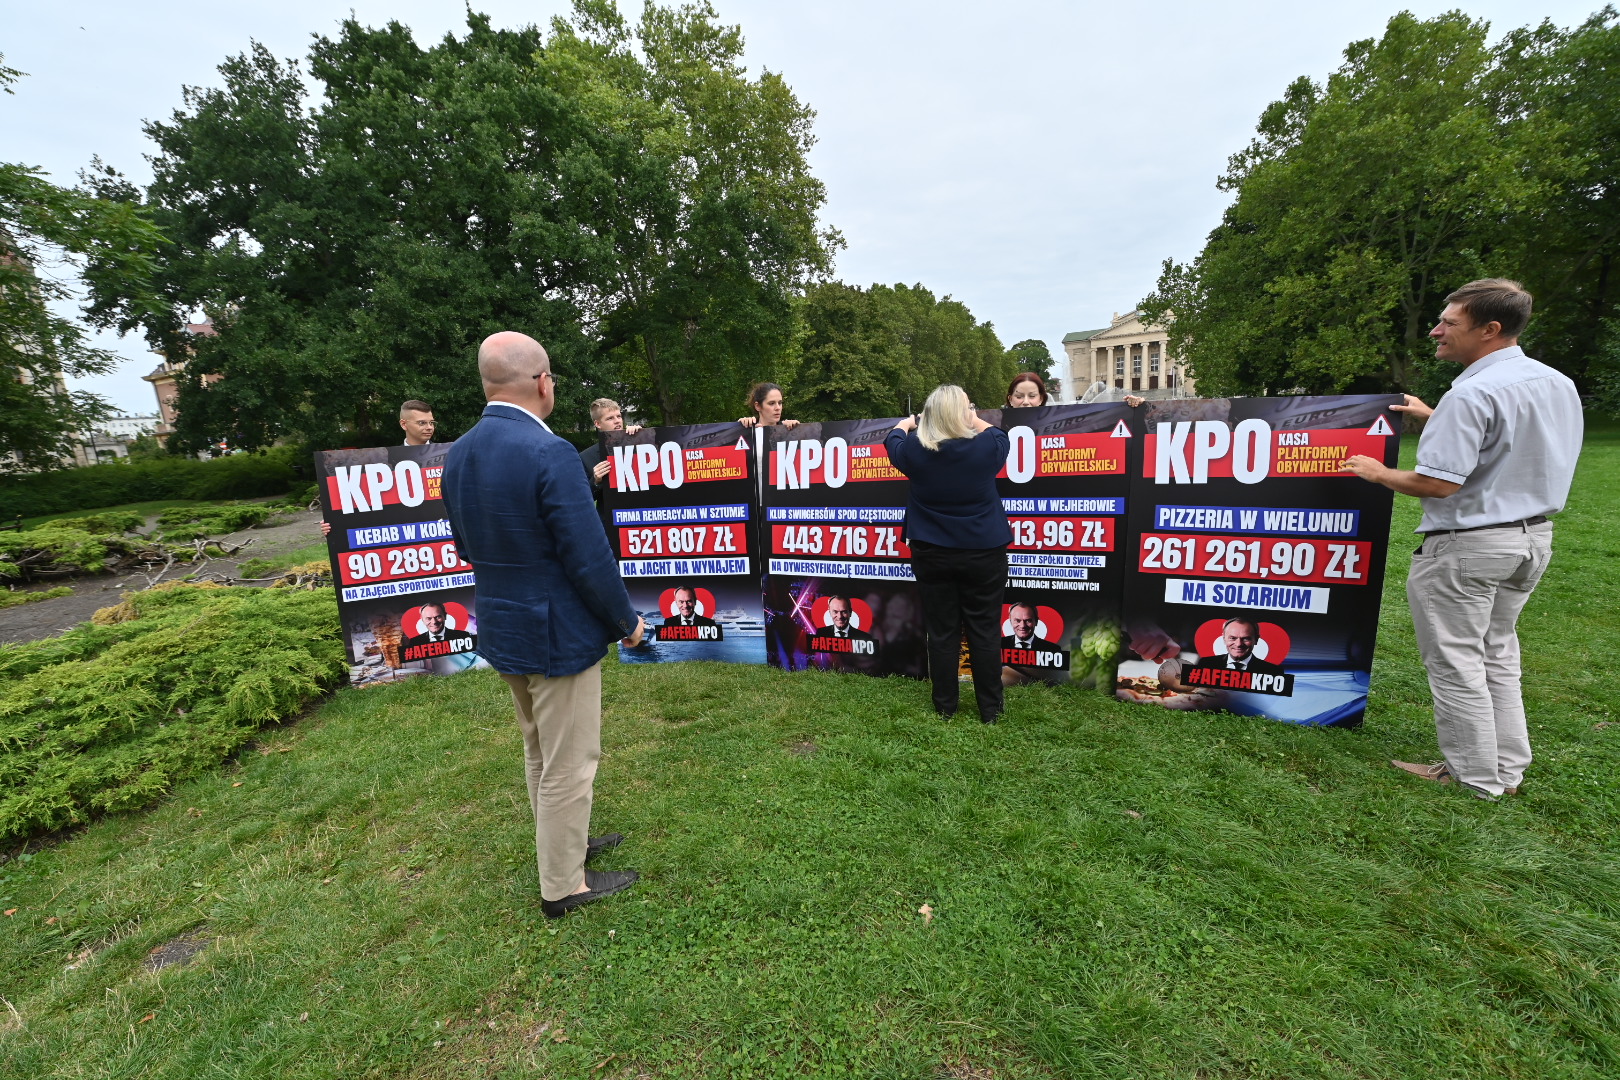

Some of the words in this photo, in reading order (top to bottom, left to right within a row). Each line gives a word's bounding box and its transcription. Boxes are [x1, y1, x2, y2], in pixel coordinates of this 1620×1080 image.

[1044, 416, 1086, 432] EURO
[1282, 409, 1337, 428] EURO
[1041, 437, 1066, 449] KASA
[1278, 433, 1309, 446] KASA
[686, 450, 704, 460] KASA
[852, 447, 871, 458] KASA
[1041, 448, 1096, 462] PLATFORMY
[1155, 418, 1272, 484] KPO
[1277, 446, 1348, 460] PLATFORMY
[613, 441, 684, 493] KPO
[686, 458, 726, 470] PLATFORMY
[776, 437, 848, 490] KPO
[852, 456, 893, 468] PLATFORM
[1041, 458, 1117, 474] OBYWATELSKIEJ
[1276, 460, 1354, 473] OBYWATELS
[688, 467, 742, 480] OBYWATELSKIEJ
[335, 460, 424, 515] KPO
[616, 510, 640, 522] FIRMA
[642, 508, 698, 521] REKREACYJNA
[699, 508, 708, 519] W
[710, 506, 746, 518] SZTUMIE
[770, 508, 786, 520] KLUB
[788, 507, 836, 520] SWINGERSÓW
[838, 509, 858, 520] SPOD
[1038, 500, 1048, 512] W
[1050, 500, 1116, 512] WEJHEROWIE
[1158, 508, 1234, 530] PIZZERIA
[1240, 510, 1258, 530] W
[1263, 510, 1354, 534] WIELUNIU
[355, 526, 399, 546] KEBAB
[402, 524, 416, 541] W
[628, 528, 662, 554] 521
[667, 527, 707, 553] 807
[713, 526, 736, 552] ZŁ
[782, 526, 822, 554] 443
[830, 526, 868, 555] 716
[874, 528, 900, 556] ZŁ
[1008, 520, 1074, 549] 13,96
[1080, 521, 1106, 548] ZŁ
[348, 552, 382, 580] 90
[387, 544, 468, 576] 289,6
[1012, 554, 1036, 564] OFERTY
[1038, 554, 1064, 564] SPÓŁKI
[1066, 556, 1070, 564] O
[1072, 555, 1102, 566] ŚWIEŻE,
[1142, 537, 1196, 570] 261
[1204, 539, 1315, 578] 261,90
[1324, 544, 1362, 580] ZŁ
[623, 562, 637, 576] NA
[640, 562, 672, 575] JACHT
[675, 561, 689, 574] NA
[692, 560, 746, 574] WYNAJEM
[772, 561, 782, 572] NA
[784, 562, 852, 578] DYWERSYFIKACJĘ
[1008, 567, 1022, 576] IWO
[1024, 568, 1084, 578] BEZALKOHOLOWE
[344, 589, 358, 600] NA
[360, 584, 396, 598] ZAJĘCIA
[398, 578, 444, 593] SPORTOWE
[1012, 579, 1050, 590] WALORACH
[1052, 581, 1100, 592] SMAKOWYCH
[1182, 582, 1206, 602] NA
[1212, 584, 1312, 610] SOLARIUM
[660, 626, 718, 640] #AFERAKPO
[404, 636, 473, 660] #AFERAKPO
[811, 638, 874, 654] #AFERAKPO
[1001, 648, 1062, 668] FERAKPO
[1188, 667, 1285, 693] #AFERAKPO
